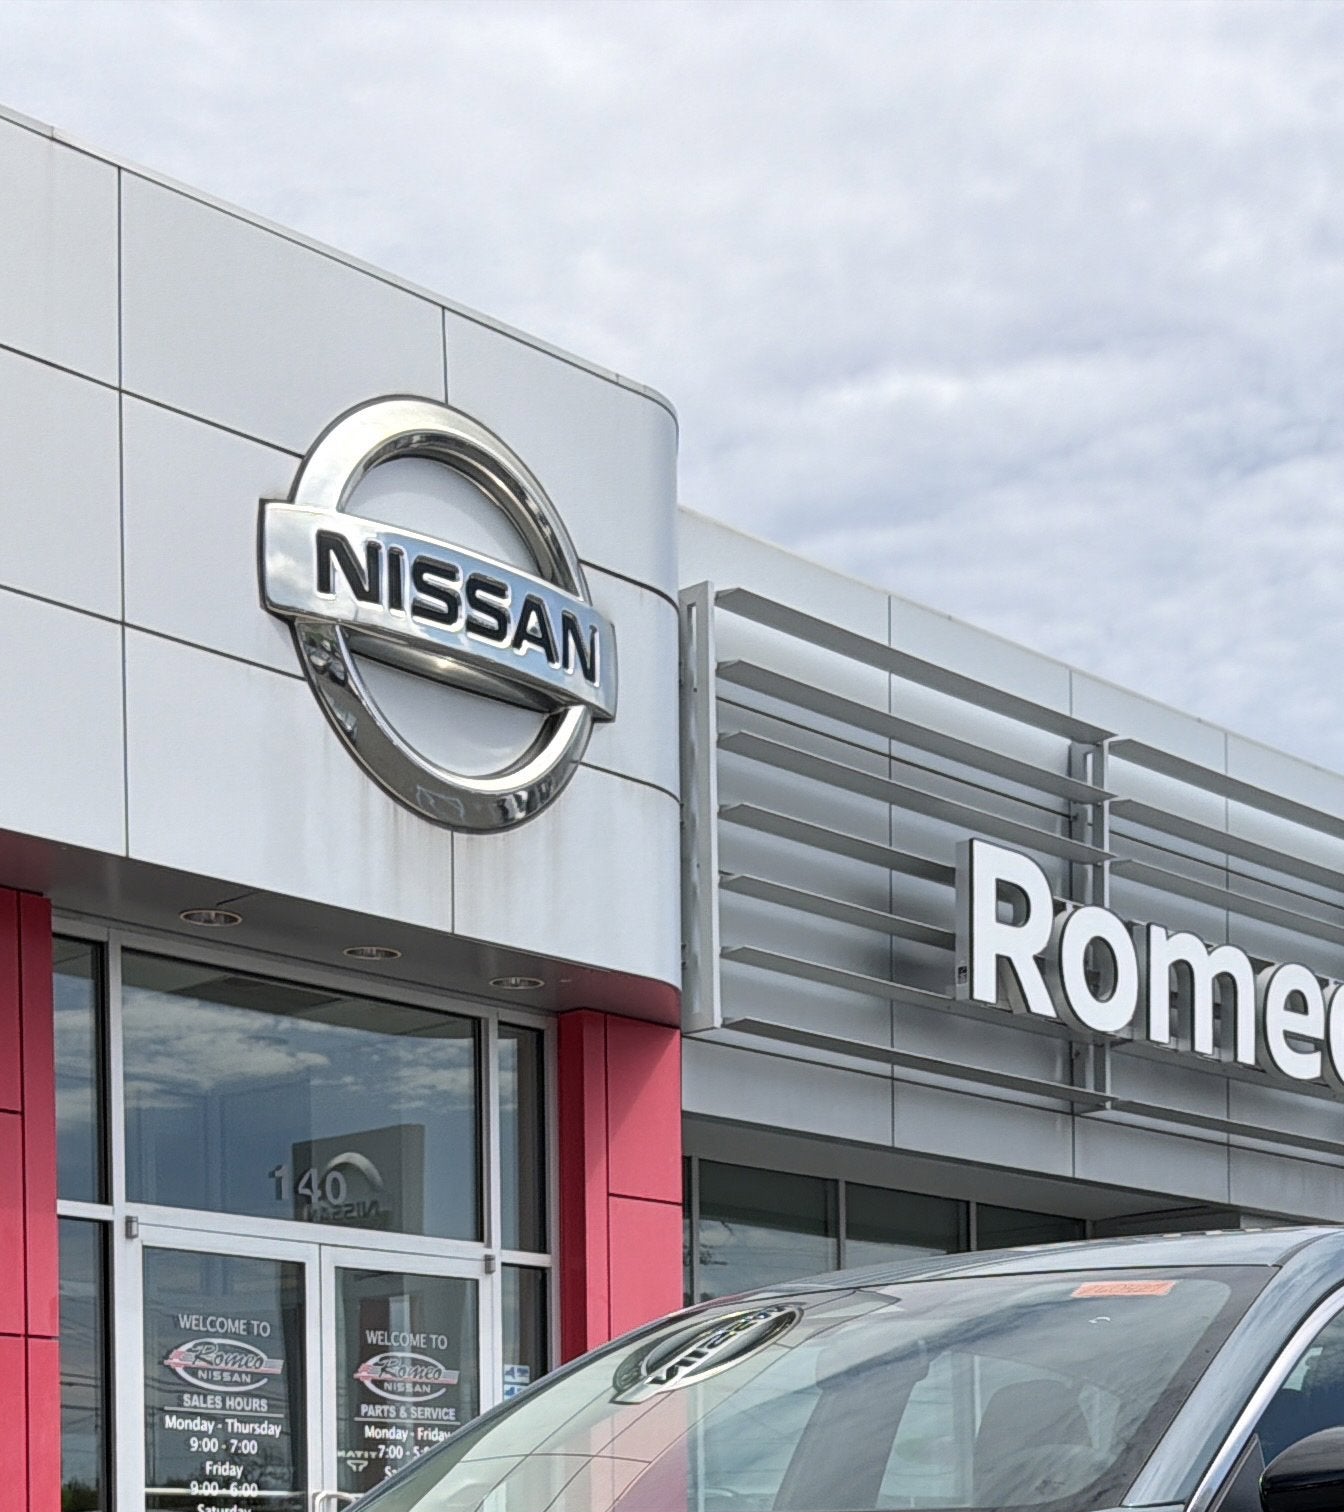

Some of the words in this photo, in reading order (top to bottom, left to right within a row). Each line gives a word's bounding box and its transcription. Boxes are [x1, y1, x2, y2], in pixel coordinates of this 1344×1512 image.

[314, 527, 601, 687] NISSAN
[269, 1163, 347, 1206] 140
[178, 1313, 248, 1336] WELCOME
[251, 1320, 271, 1337] TO
[365, 1329, 427, 1349] WELCOME
[430, 1334, 448, 1350] TO
[190, 1341, 265, 1370] Romeo
[197, 1369, 252, 1384] NISSAN
[375, 1356, 443, 1380] Romeo
[383, 1382, 431, 1394] NISSAN
[182, 1393, 223, 1409] SALES
[225, 1396, 268, 1412] HOURS
[360, 1404, 396, 1418] PARTS
[399, 1406, 407, 1419] &
[410, 1405, 456, 1420] SERVICE
[164, 1414, 215, 1436] Monday
[225, 1418, 282, 1438] Thursday
[364, 1425, 409, 1442] Monday
[417, 1427, 451, 1442] Friday
[189, 1436, 219, 1453] 9:00
[229, 1439, 258, 1454] 7:00
[378, 1444, 404, 1459] 7:00
[205, 1460, 244, 1479] Friday
[189, 1480, 219, 1497] 9:00
[229, 1481, 259, 1498] 6:00
